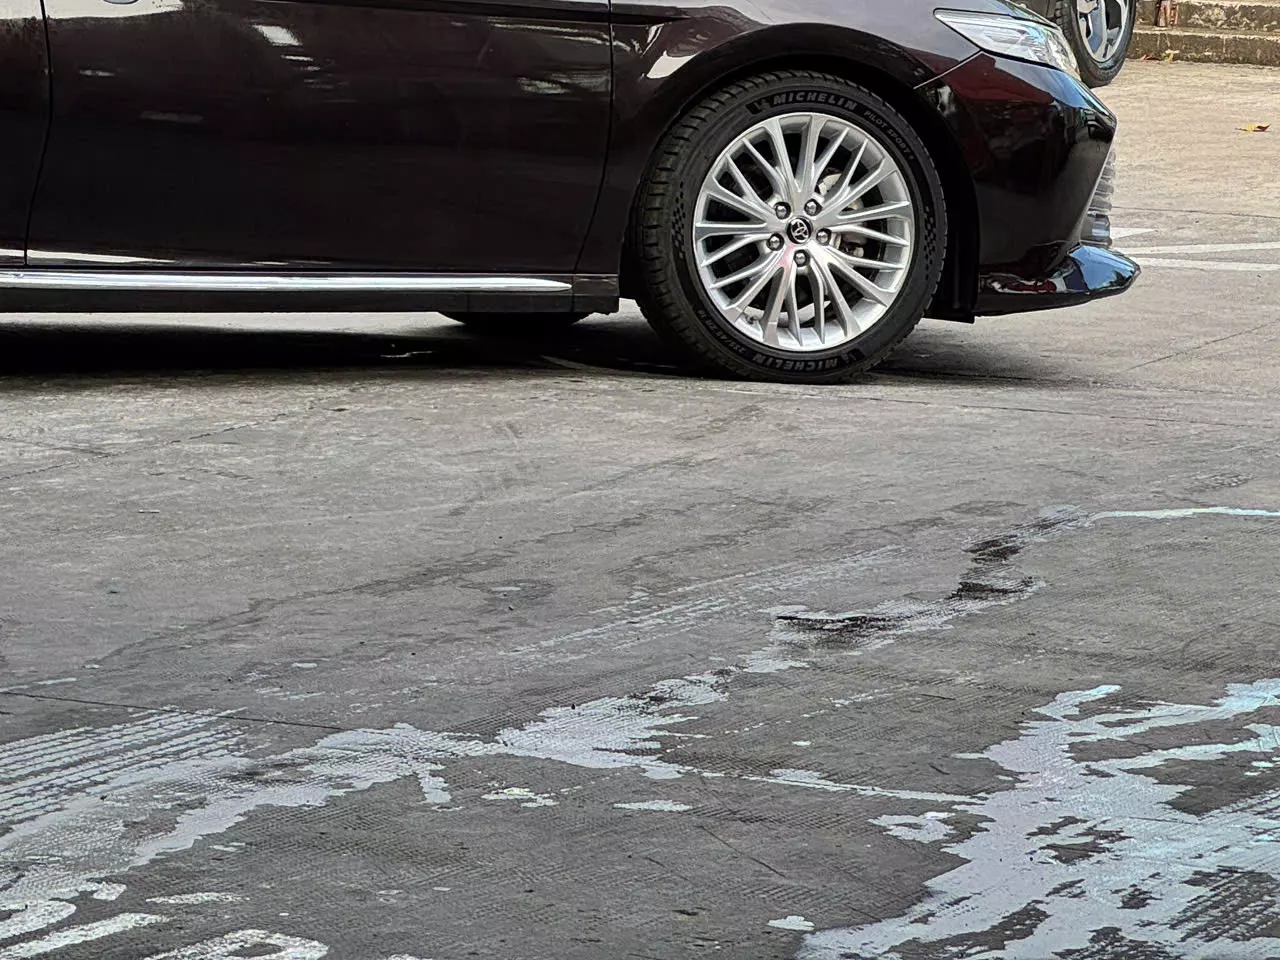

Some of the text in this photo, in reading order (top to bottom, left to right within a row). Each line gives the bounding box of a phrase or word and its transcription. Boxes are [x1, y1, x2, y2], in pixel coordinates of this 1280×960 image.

[773, 91, 858, 112] MICHELIN
[863, 110, 887, 129] PILOT
[888, 128, 912, 155] SPORT
[752, 353, 838, 372] MICHELIN
